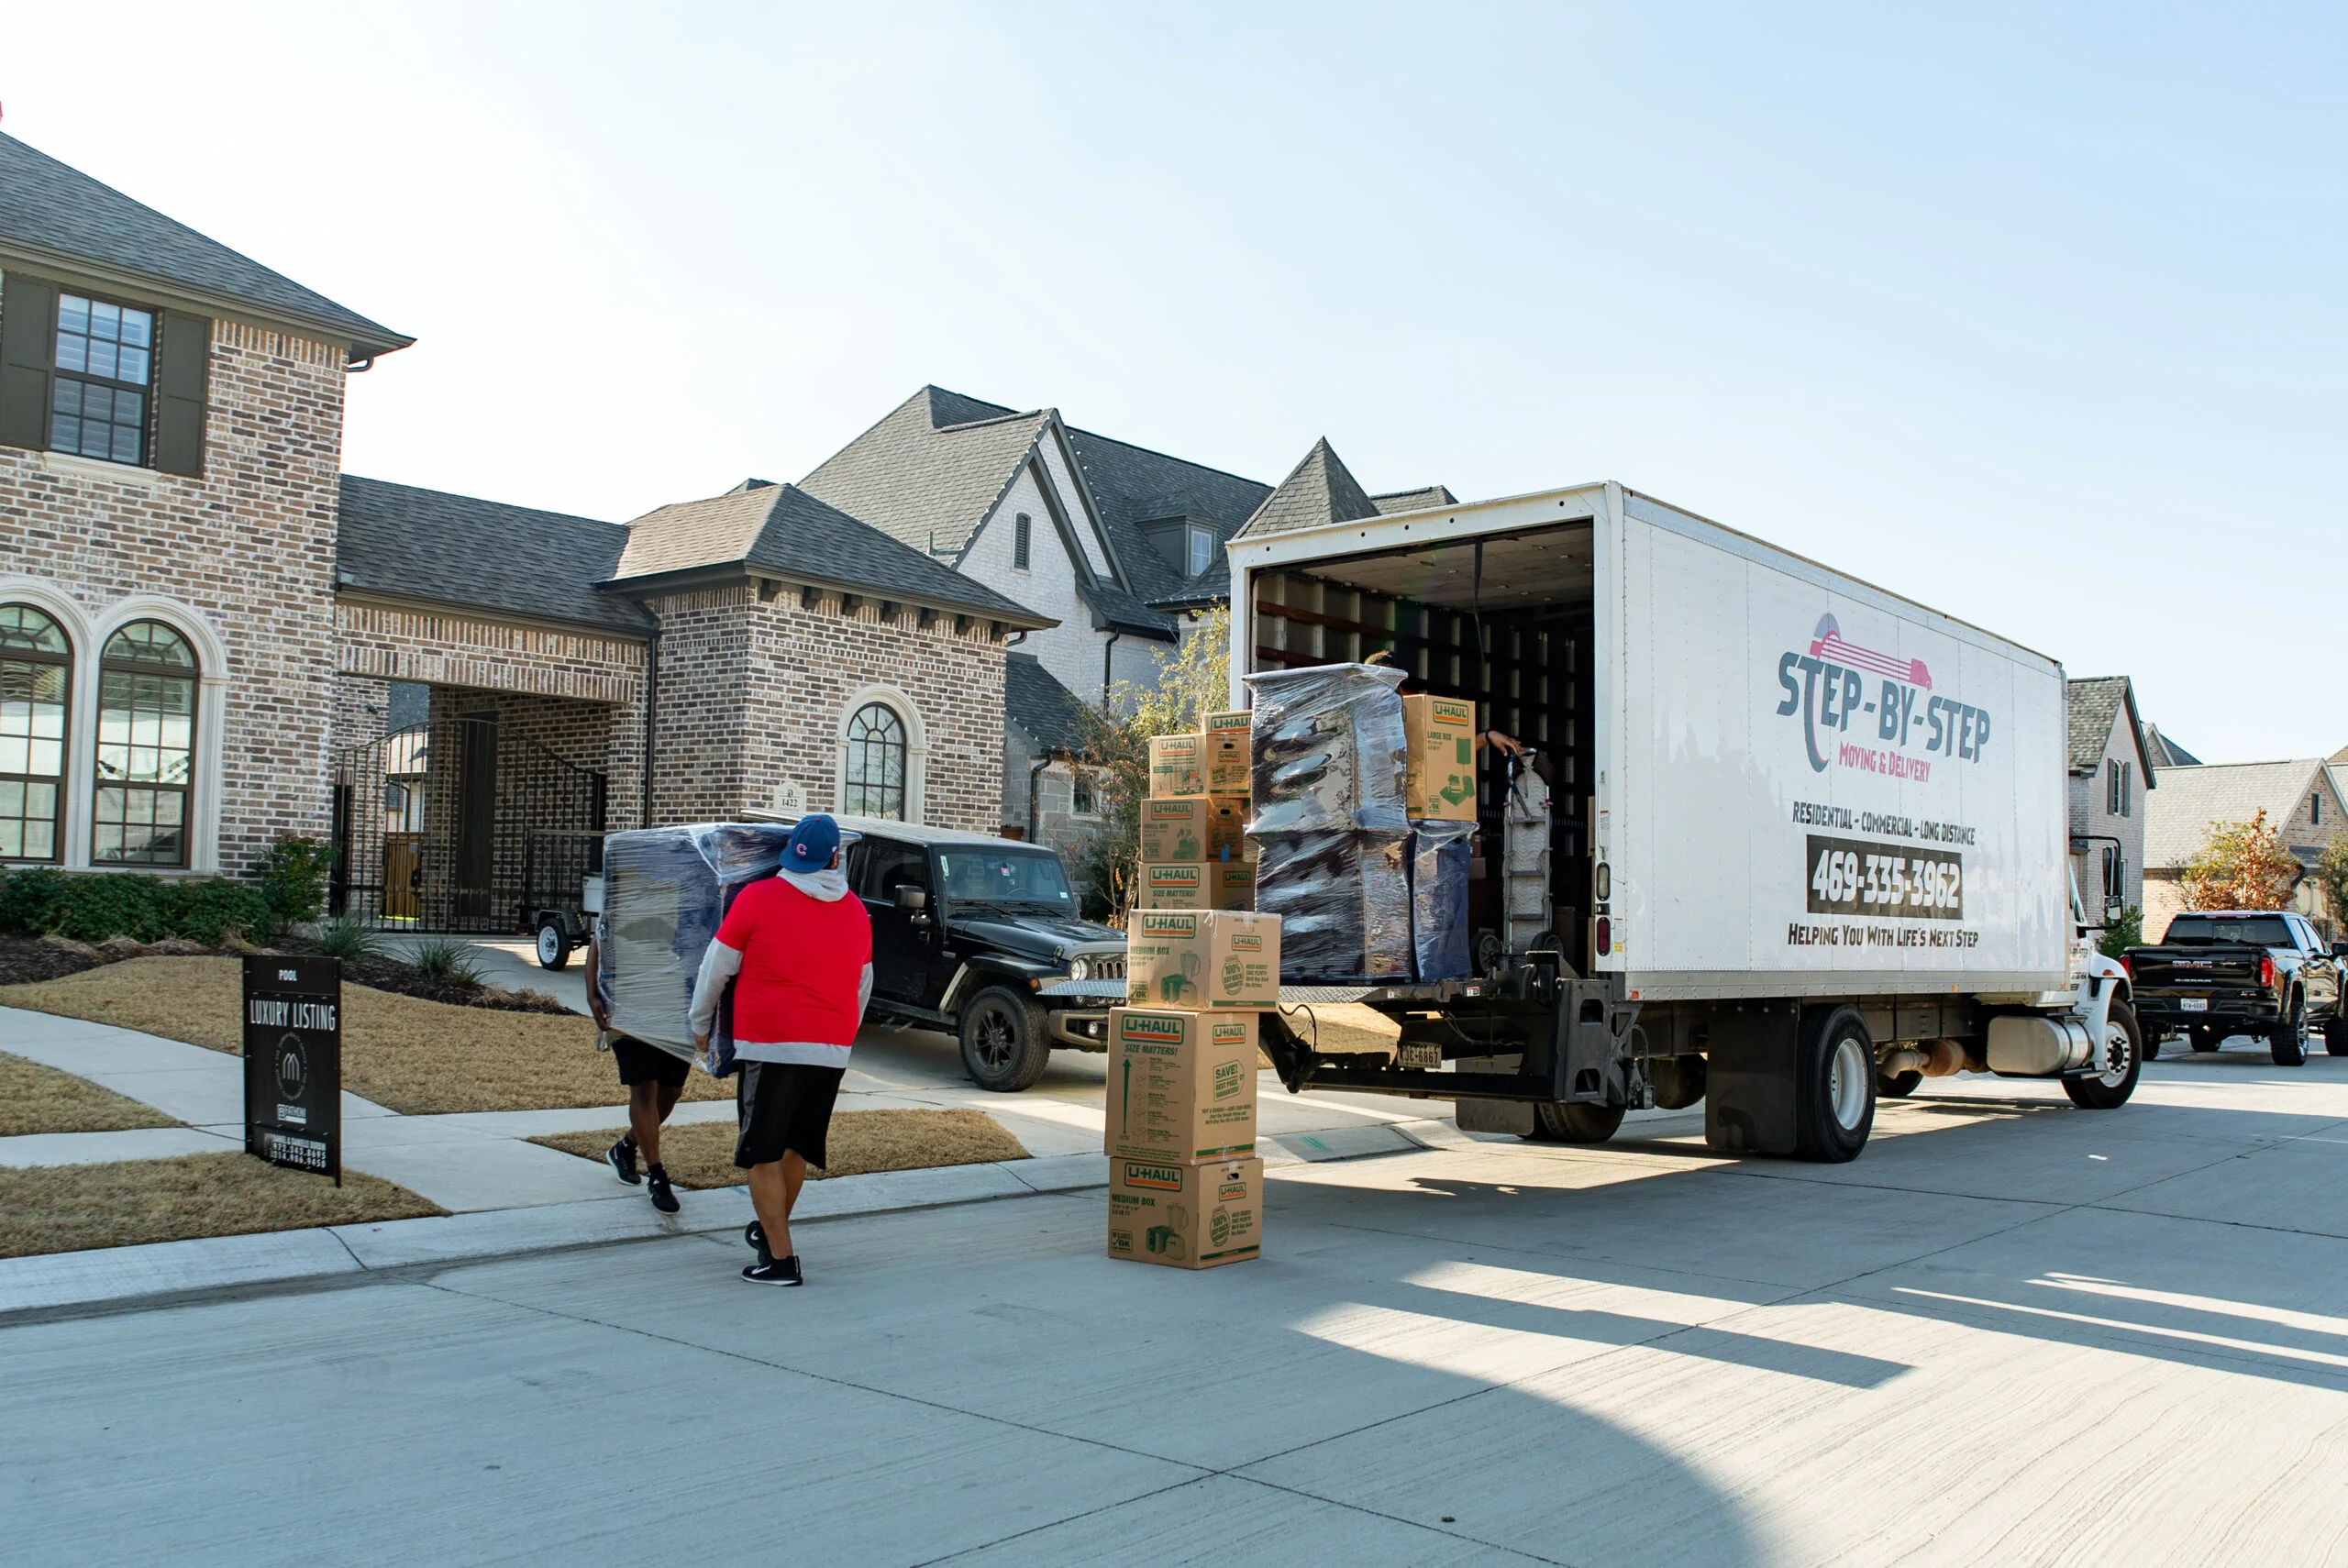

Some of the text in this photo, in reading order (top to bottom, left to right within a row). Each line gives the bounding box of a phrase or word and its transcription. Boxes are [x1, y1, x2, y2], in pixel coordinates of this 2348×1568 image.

[1434, 704, 1467, 718] U-HAUL
[1777, 651, 1990, 772] STEP-BY-STEP
[1161, 741, 1193, 750] U-HAUL
[1838, 740, 1932, 783] MOVING & DELIVERY
[781, 799, 798, 807] 1422
[1154, 805, 1191, 813] U-HAUL
[1792, 801, 1854, 830] RESIDENTIAL
[1861, 812, 1913, 838] COMMERCIAL
[1920, 821, 1940, 841] LONG
[1941, 824, 1976, 845] DISTANCE
[796, 843, 807, 856] C
[1152, 868, 1197, 880] U-HAUL
[1811, 849, 1961, 909] 469-335-3962
[1166, 889, 1196, 898] MATTERS!
[1146, 917, 1192, 930] U-HAUL
[1233, 937, 1260, 946] U-HAUL
[1788, 923, 1978, 948] HELPING YOU WITH LIFE'S NEXT STEP
[1130, 946, 1170, 955] MEDIUM BOX
[278, 969, 297, 981] POOL
[249, 999, 337, 1032] LUXURY LISTING
[1125, 1019, 1180, 1034] U-HAUL
[1214, 1026, 1244, 1038] U-HAUL
[1124, 1043, 1179, 1055] SIZE MATTERS!
[1215, 1064, 1238, 1079] SAVE!
[1128, 1166, 1180, 1183] U-HAUL
[1220, 1184, 1245, 1195] U-HAUL
[1112, 1193, 1156, 1207] MEDIUM BOX
